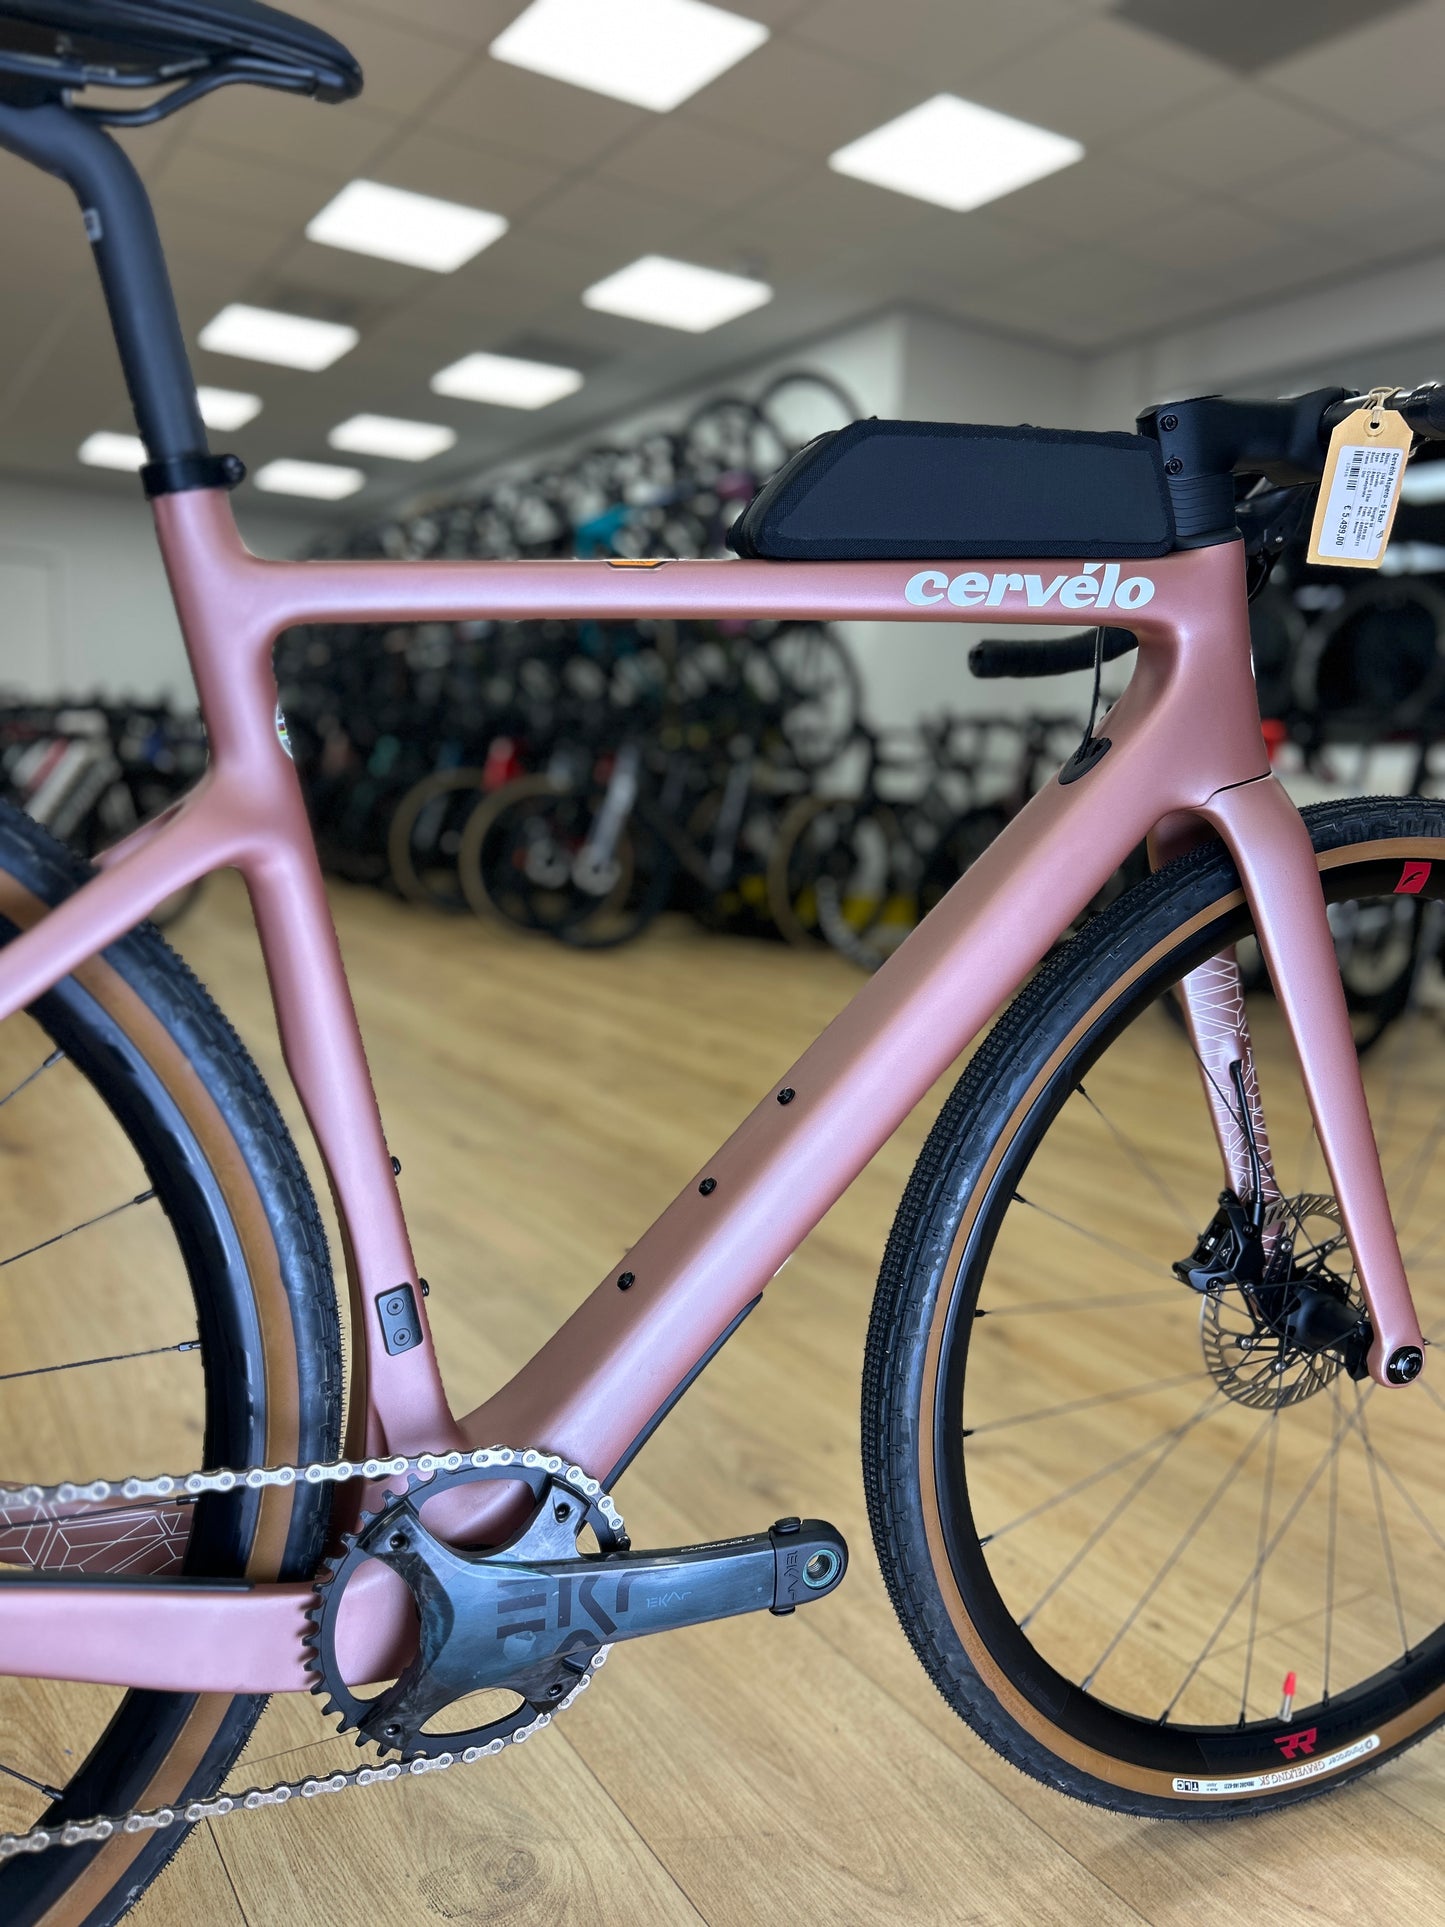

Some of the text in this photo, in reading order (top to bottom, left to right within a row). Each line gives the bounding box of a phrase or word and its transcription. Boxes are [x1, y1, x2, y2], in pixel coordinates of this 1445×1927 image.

[1334, 512, 1349, 545] 5.499,00
[1377, 510, 1385, 522] Ekar
[904, 563, 1155, 610] cervélo
[1259, 1744, 1364, 1787] Panaracer GRAVELKING SK
[1177, 1780, 1199, 1792] TLC
